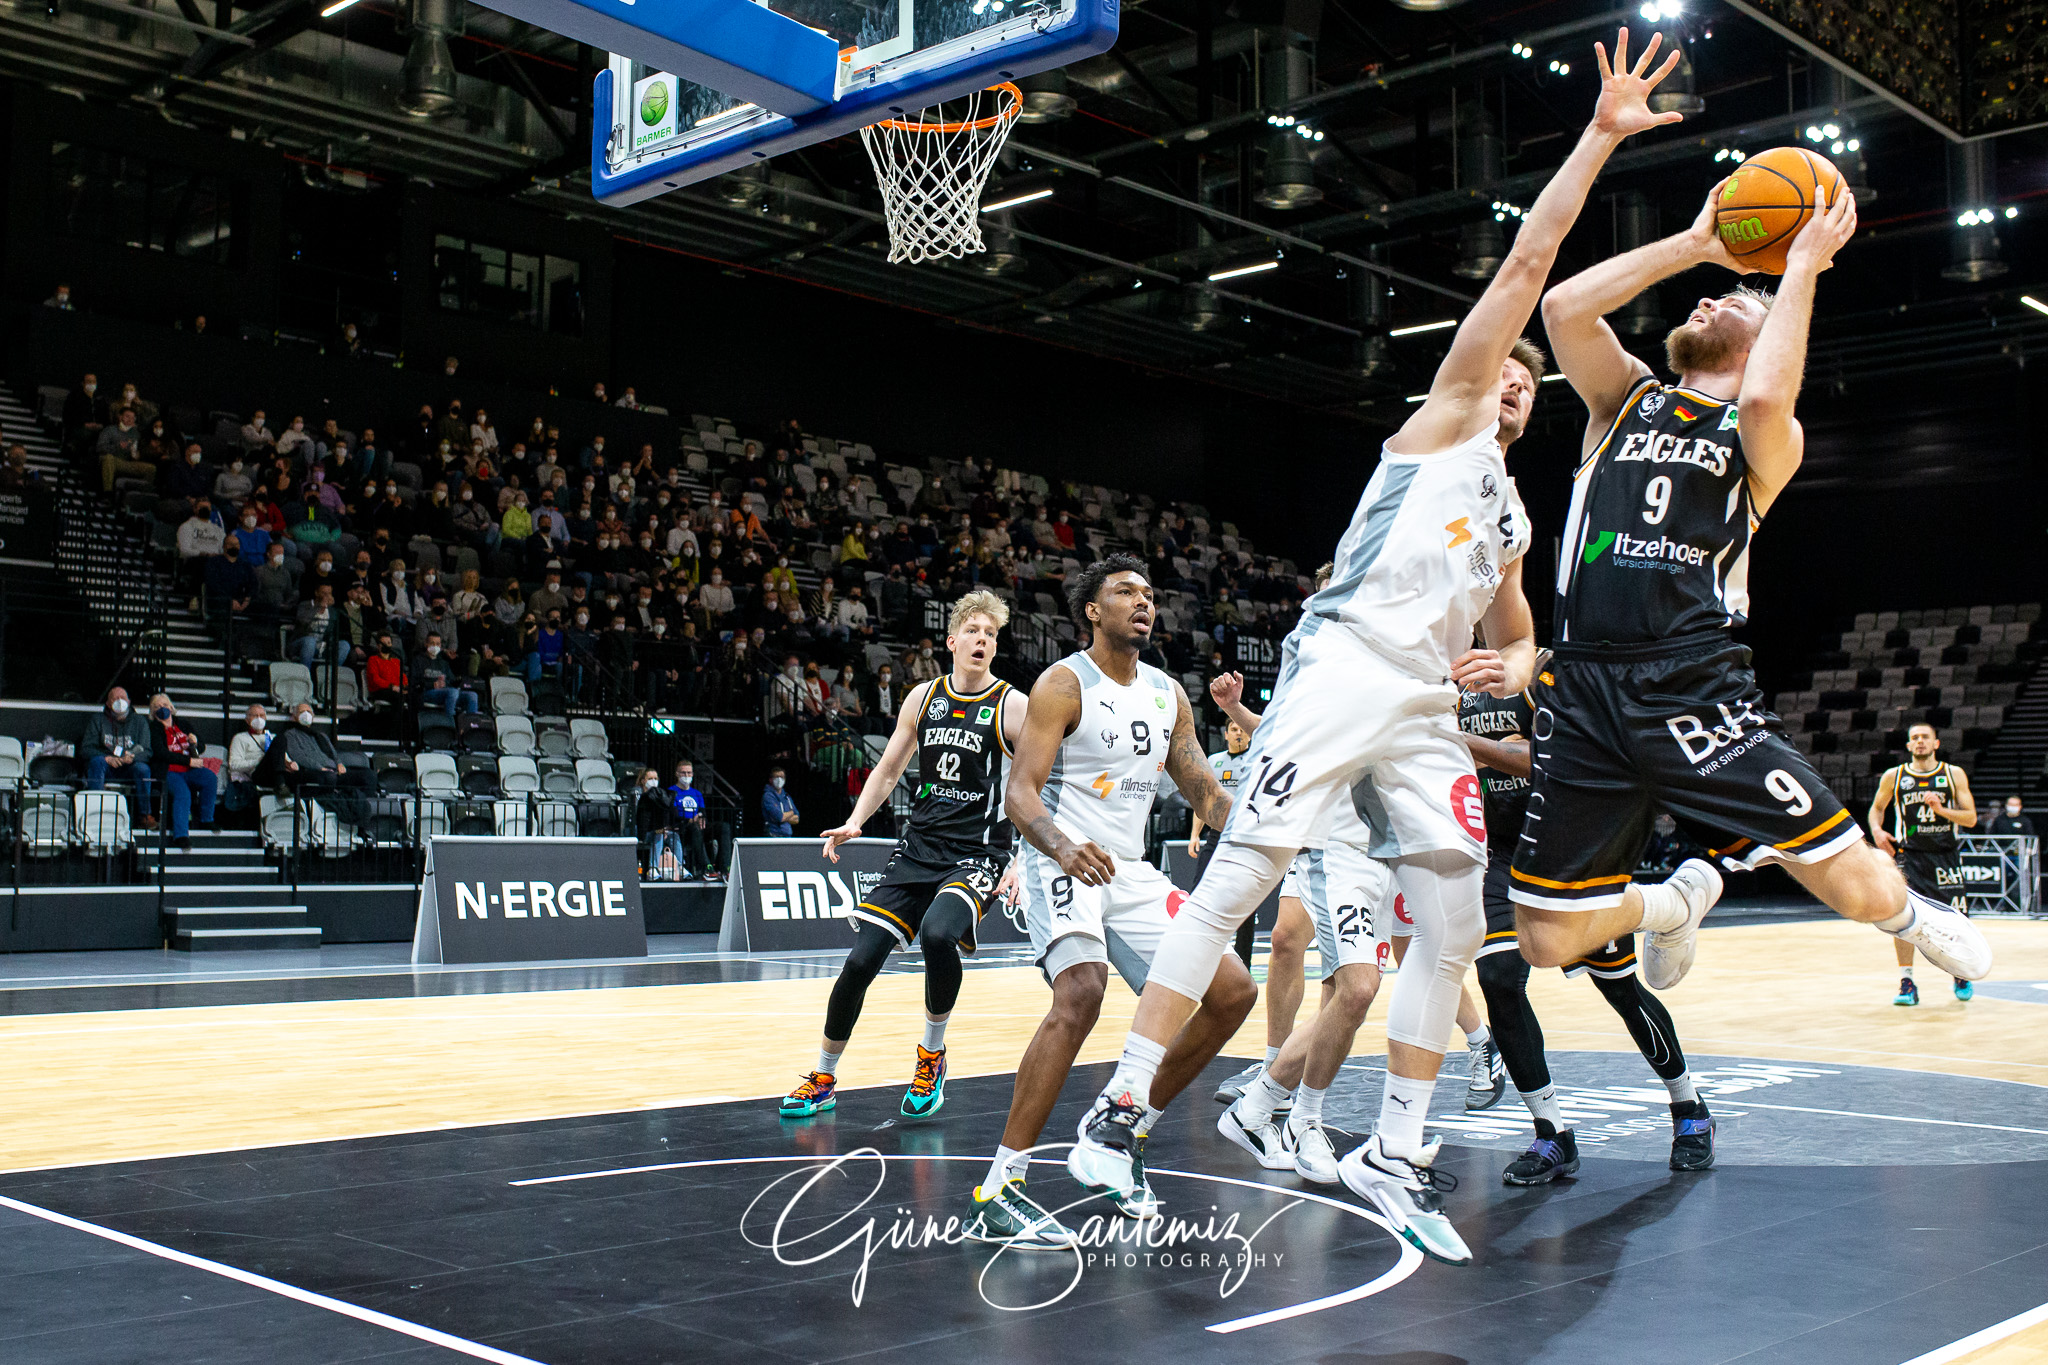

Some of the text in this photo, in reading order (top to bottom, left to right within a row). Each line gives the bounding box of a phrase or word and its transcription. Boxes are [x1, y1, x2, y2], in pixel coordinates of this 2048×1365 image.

[636, 126, 672, 147] BARMER
[1614, 430, 1733, 477] EAGLES
[1642, 475, 1673, 525] 9
[1612, 555, 1686, 575] Versicherungen
[1613, 532, 1710, 567] Itzehoer
[1130, 720, 1152, 755] 9
[1461, 711, 1521, 735] EAGLES
[924, 727, 983, 754] EAGLES
[1696, 729, 1772, 778] WIR SIND MODE
[936, 752, 960, 782] 42
[1249, 755, 1299, 807] 14
[930, 783, 985, 802] Itzehoer
[1764, 769, 1813, 817] 9
[1916, 805, 1936, 823] 44
[757, 871, 854, 920] EMS
[966, 870, 994, 902] 42
[1051, 875, 1074, 909] 9
